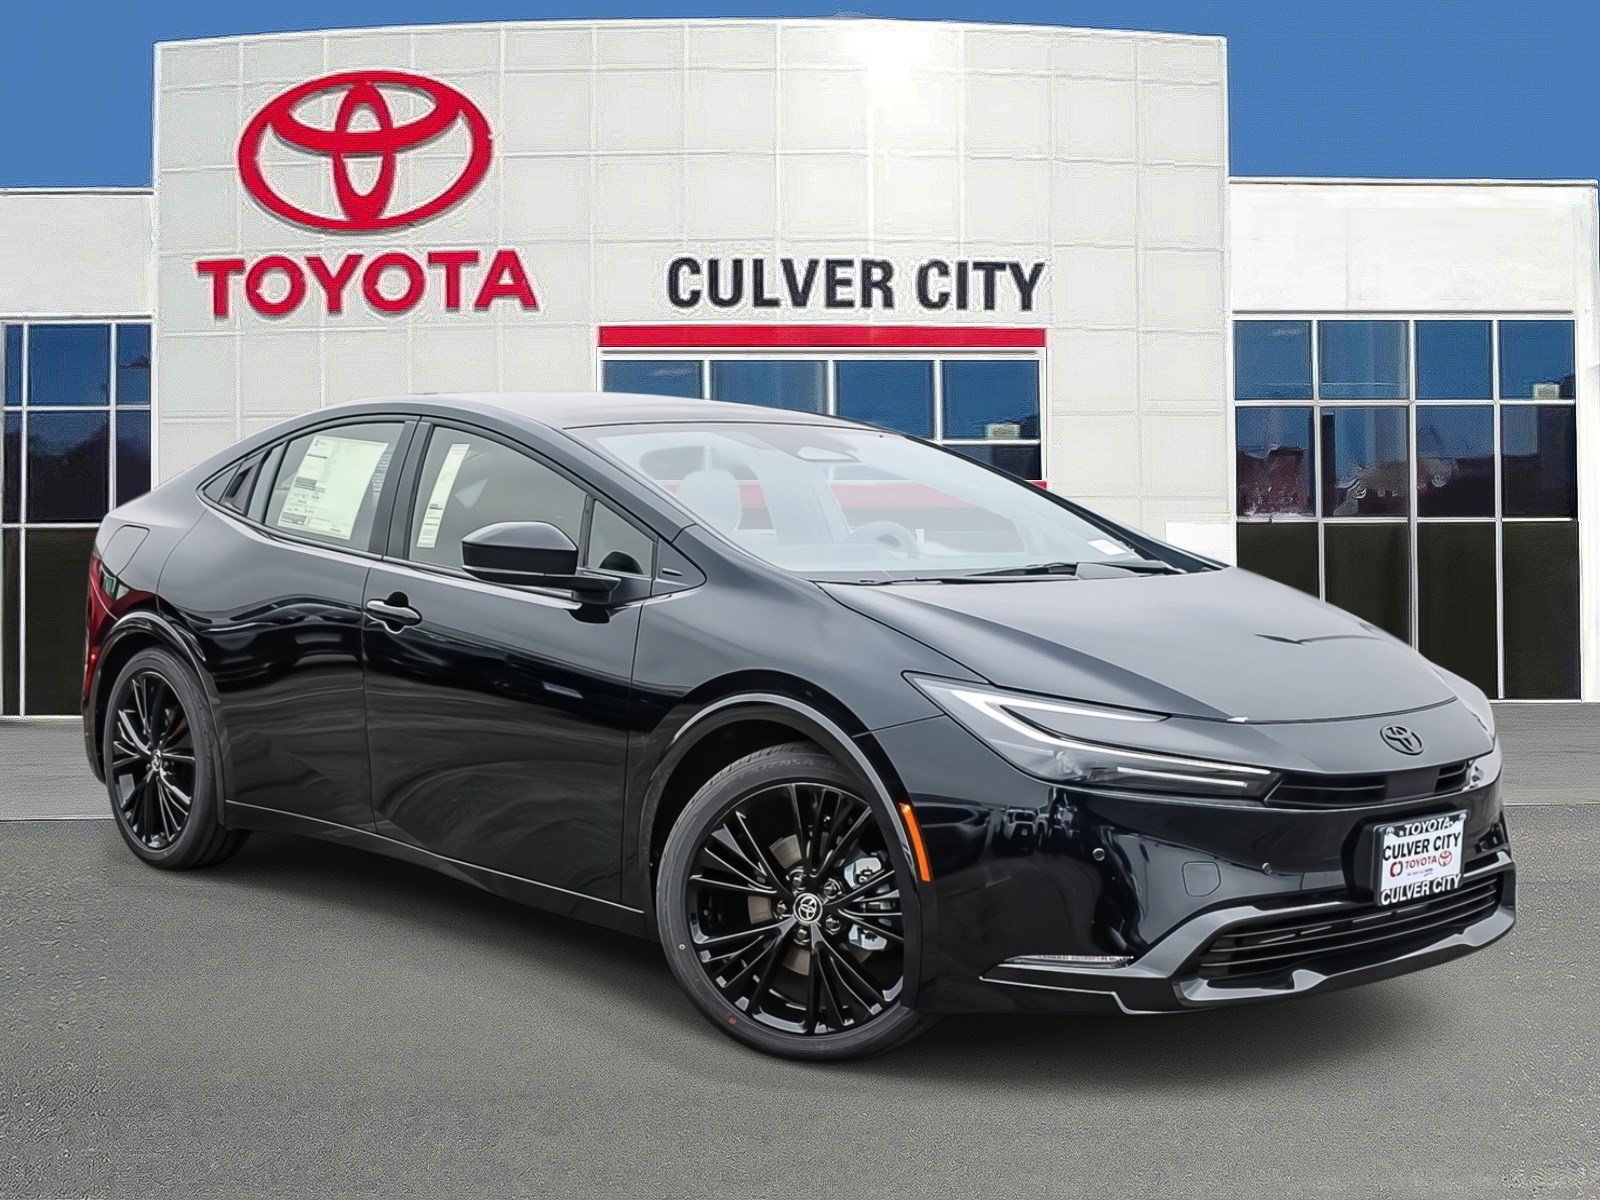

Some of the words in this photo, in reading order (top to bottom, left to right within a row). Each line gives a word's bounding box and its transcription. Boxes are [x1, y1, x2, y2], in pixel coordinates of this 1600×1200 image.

[196, 250, 539, 318] TOYOTA
[668, 257, 895, 308] CULVER
[915, 259, 1045, 311] CITY
[1404, 817, 1450, 836] TOYOTA
[1383, 839, 1430, 861] CULVER
[1433, 832, 1461, 851] CITY
[1405, 855, 1437, 869] TOYOTA
[1381, 881, 1430, 905] CULVER
[1432, 874, 1461, 893] CITY
